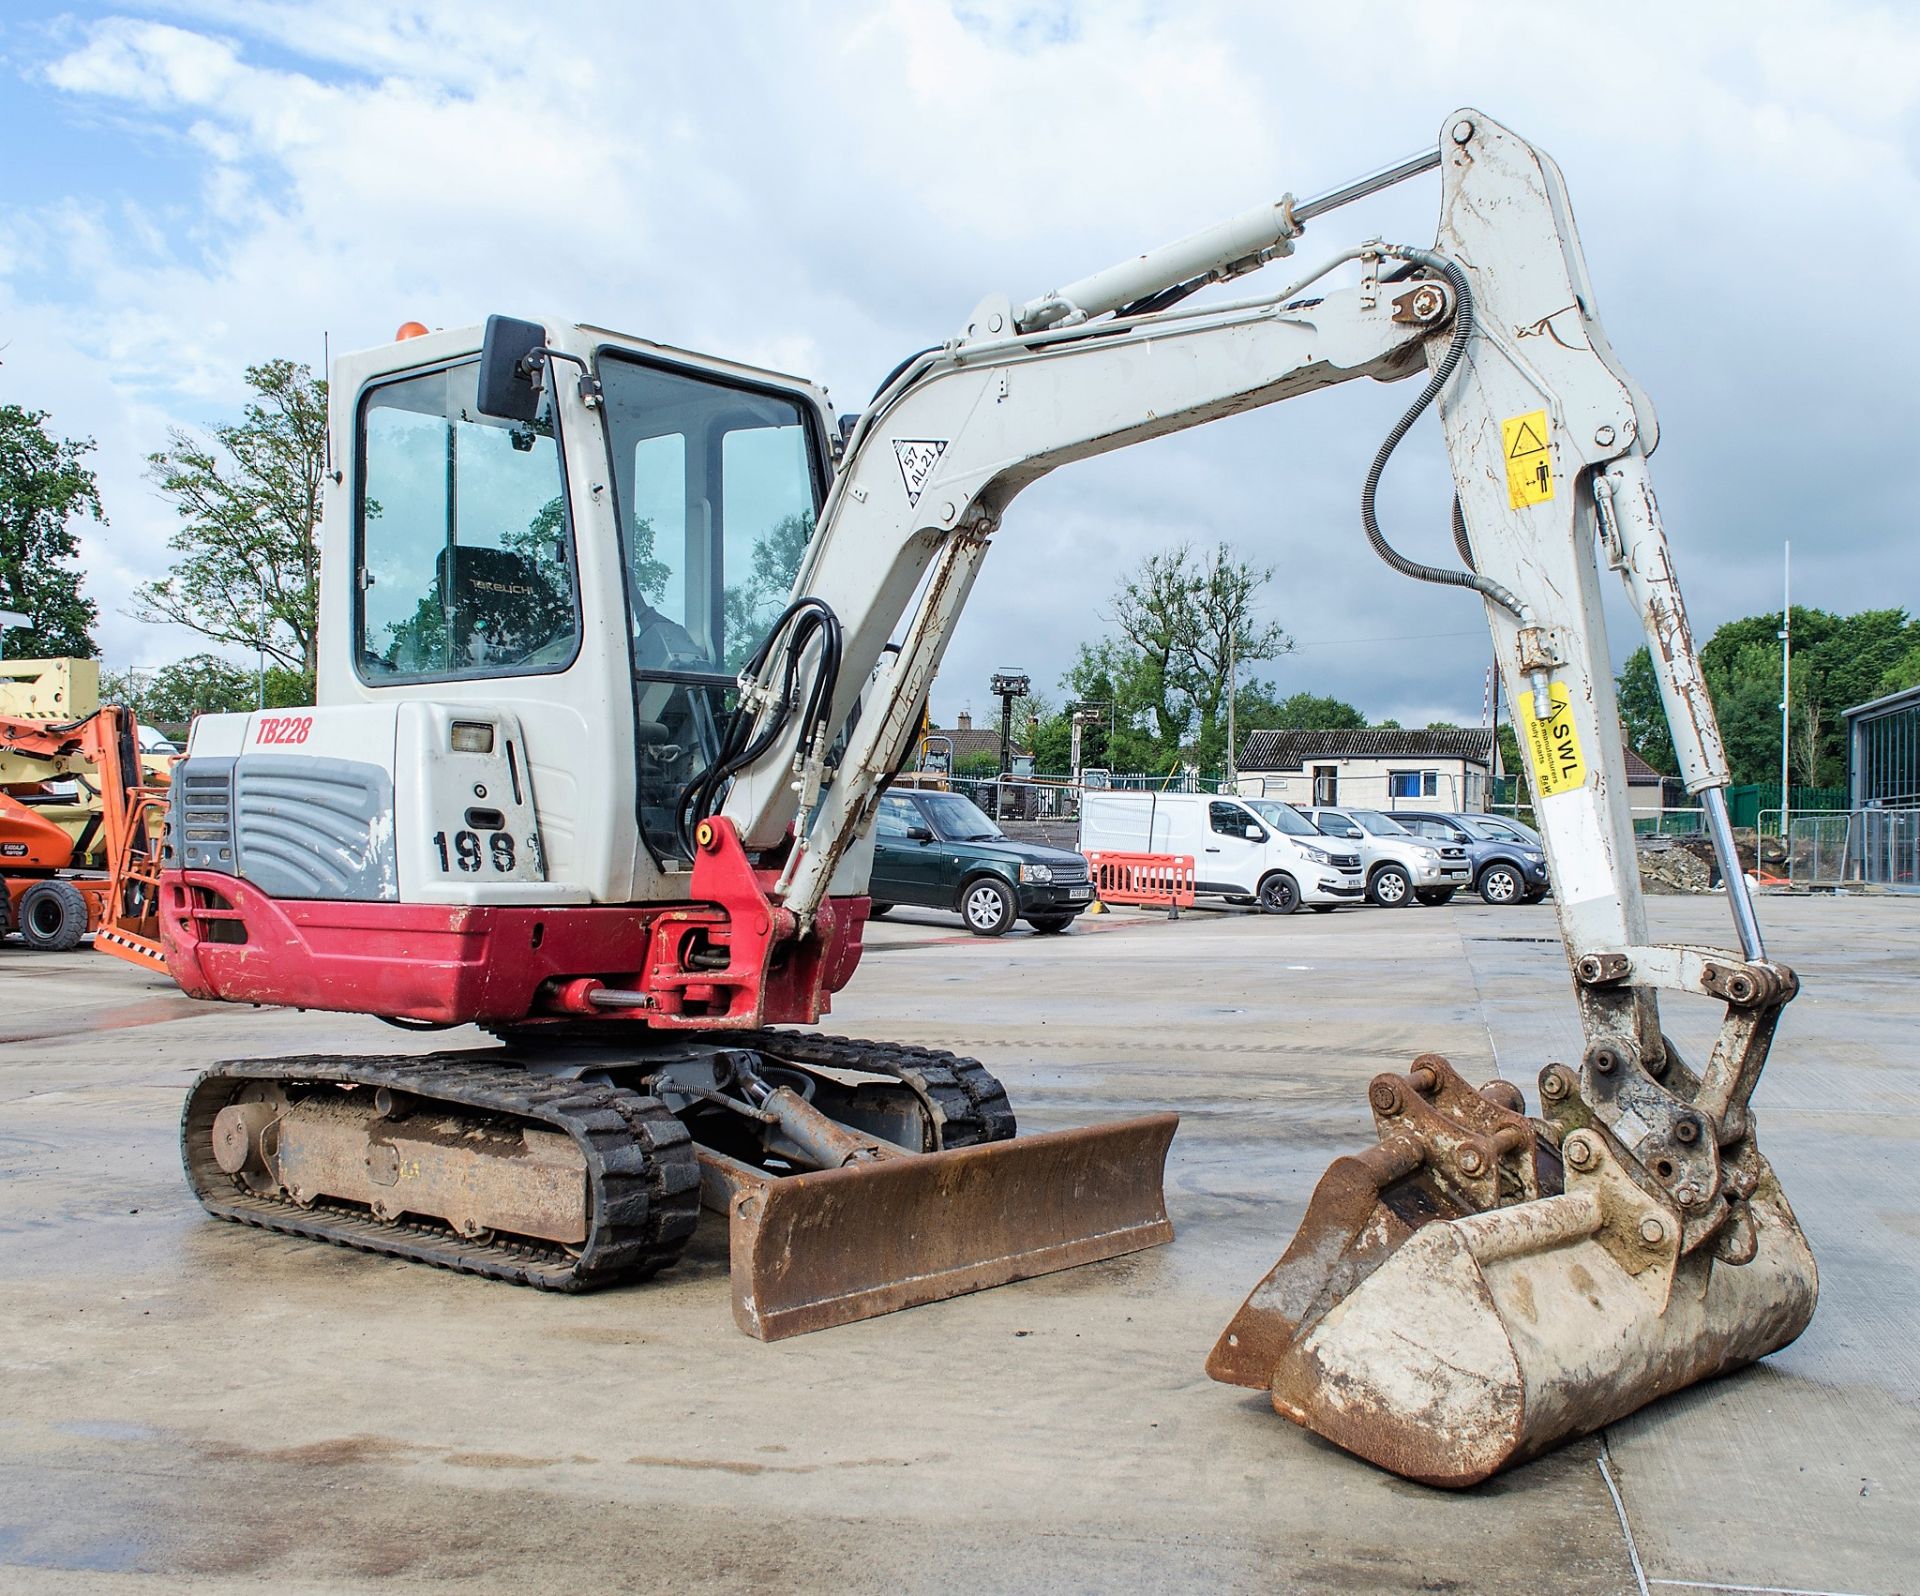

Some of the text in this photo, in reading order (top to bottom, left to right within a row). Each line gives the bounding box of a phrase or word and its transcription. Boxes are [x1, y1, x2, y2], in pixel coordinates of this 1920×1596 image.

[904, 446, 918, 469] 57
[256, 717, 313, 744] TB228
[1535, 740, 1545, 765] charts
[1542, 729, 1559, 784] manufacturers
[1553, 723, 1578, 779] SWL
[433, 830, 516, 872] 198
